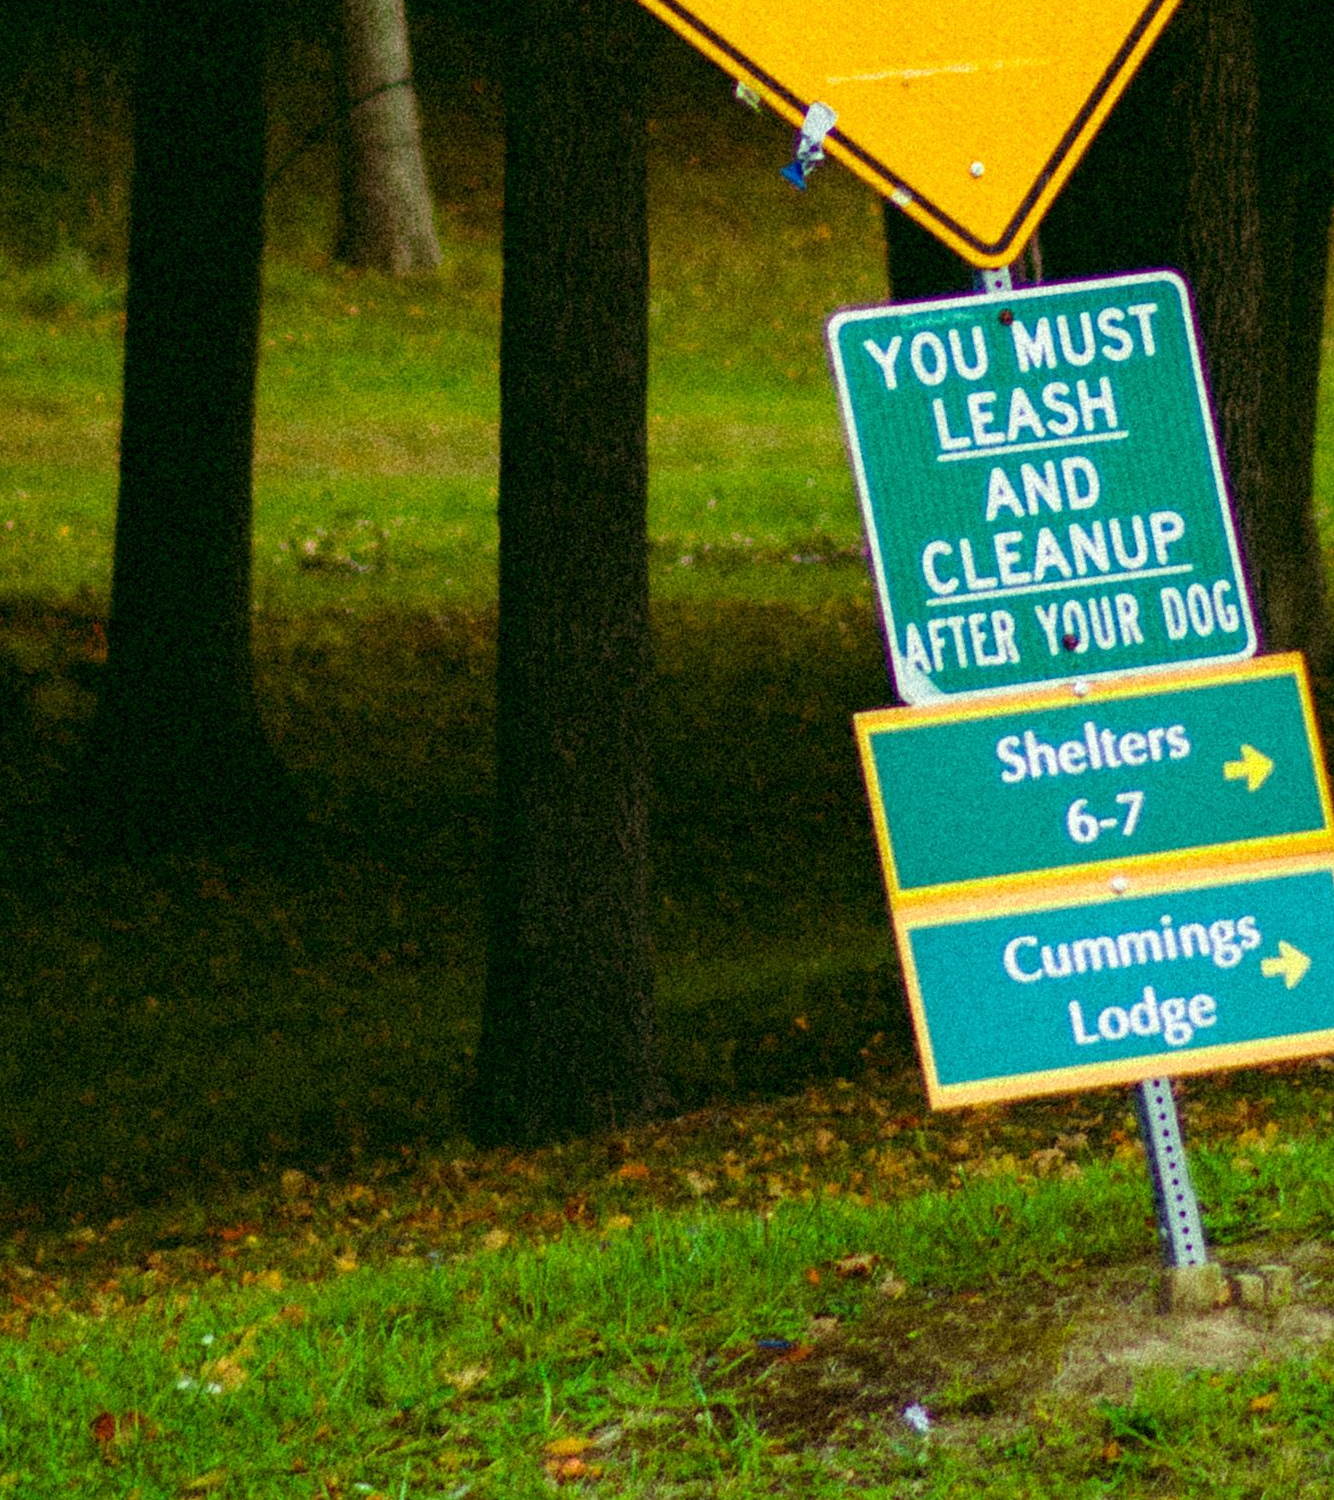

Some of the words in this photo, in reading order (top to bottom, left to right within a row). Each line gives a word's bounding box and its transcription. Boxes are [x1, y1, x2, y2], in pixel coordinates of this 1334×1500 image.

[864, 326, 989, 390] YOU
[1012, 303, 1158, 374] MUST
[933, 376, 1119, 451] LEASH
[985, 456, 1101, 522] AND
[922, 510, 1185, 596] CLEANUP
[906, 609, 1021, 675] AFTER
[1036, 593, 1144, 657] YOUR
[1161, 579, 1240, 641] DOG
[996, 721, 1191, 784] Shelters
[1066, 791, 1144, 844] 6-7
[1003, 914, 1261, 984] Cummings
[1069, 986, 1217, 1047] Lodge
